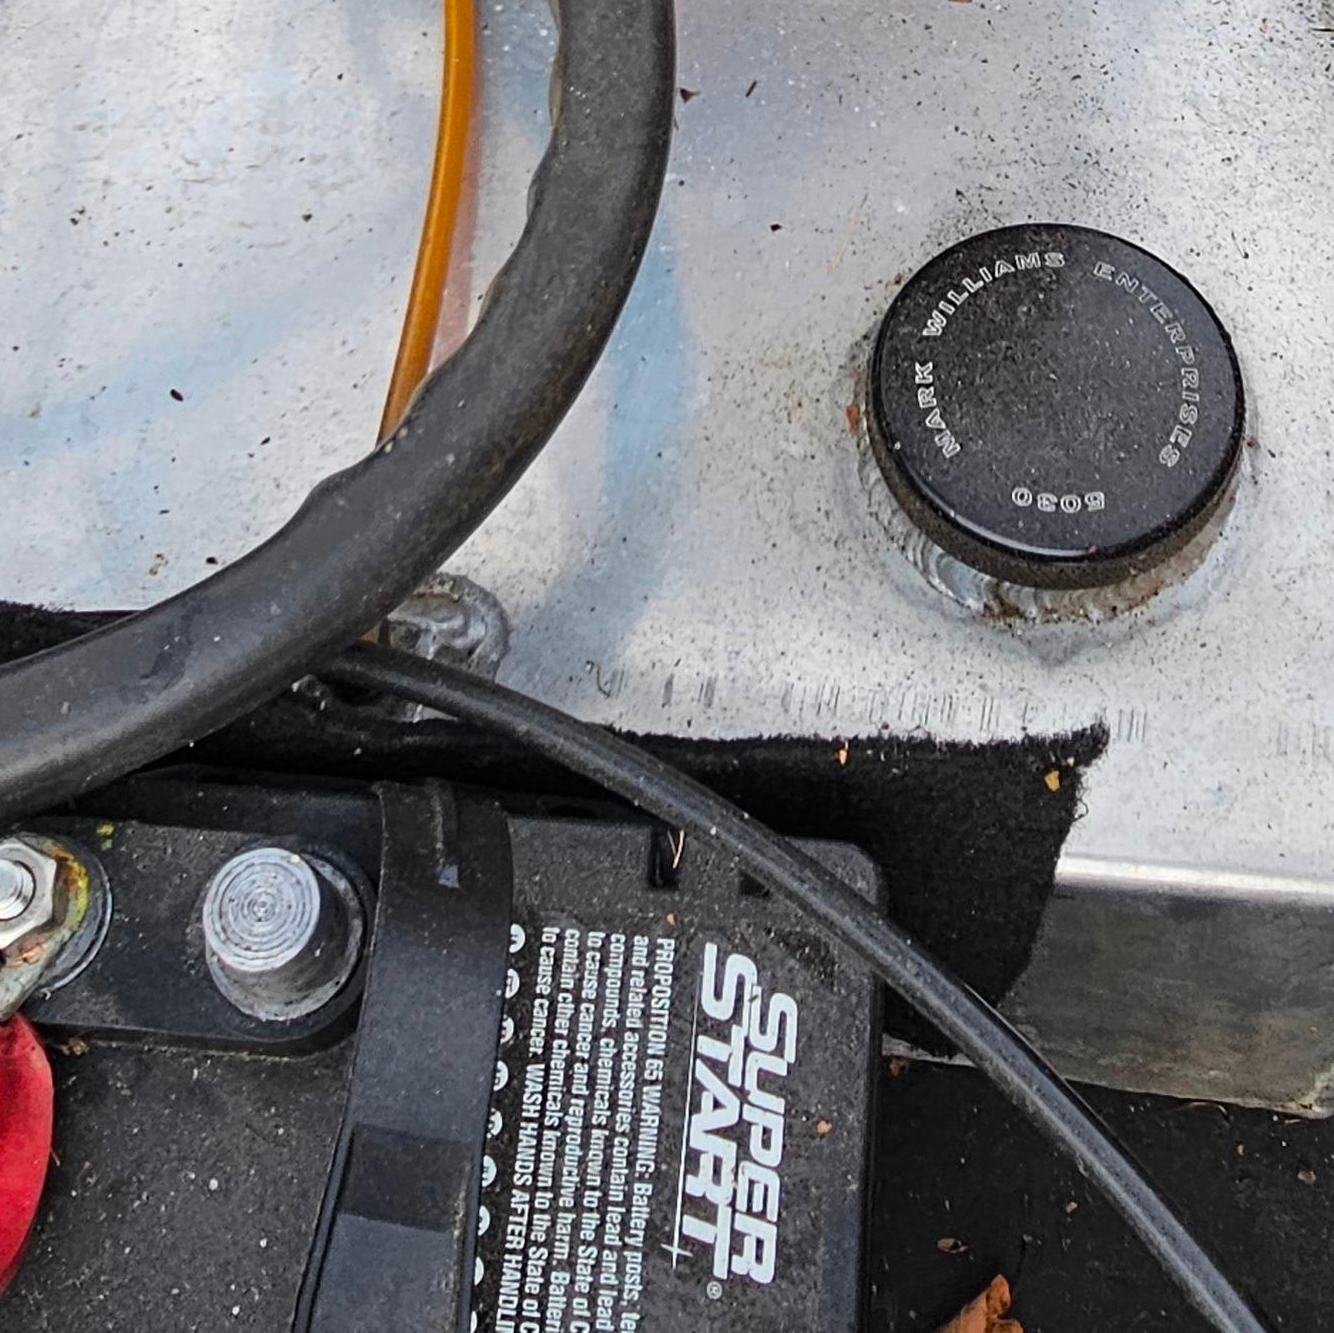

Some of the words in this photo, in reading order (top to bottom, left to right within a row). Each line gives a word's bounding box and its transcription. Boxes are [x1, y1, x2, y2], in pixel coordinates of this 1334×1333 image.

[923, 251, 1066, 337] WILLIAMS
[1093, 261, 1200, 467] ENTERPRISES
[915, 362, 962, 458] MARK
[542, 927, 560, 943] to
[560, 928, 580, 989] contain
[587, 932, 606, 948] to
[632, 935, 650, 967] and
[536, 946, 555, 995] cause
[582, 951, 600, 999] cause
[647, 938, 675, 1055] PROPOSITION
[626, 970, 647, 1028] related
[529, 999, 549, 1057] cancer.
[576, 1003, 595, 1059] cancer
[522, 1064, 545, 1117] WASH
[544, 1039, 570, 1126] chemicals
[572, 1063, 589, 1095] and
[592, 1038, 617, 1125] chemicals
[615, 1031, 639, 1133] accessories
[644, 1059, 663, 1080] 65
[635, 1084, 662, 1178] WARNING:
[682, 942, 757, 1280] START
[731, 985, 798, 1285] SUPER
[513, 1122, 538, 1185] HANDS
[537, 1130, 561, 1186] known
[559, 1098, 584, 1207] reproductive
[586, 1129, 609, 1186] known
[608, 1136, 629, 1201] contain
[506, 1189, 529, 1249] AFTER
[535, 1192, 553, 1209] to
[580, 1212, 600, 1240] the
[583, 1191, 602, 1208] to
[604, 1206, 626, 1246] lead
[624, 1182, 653, 1247] Battery
[530, 1214, 551, 1242] the
[525, 1247, 548, 1294] State
[574, 1246, 598, 1293] State
[600, 1249, 619, 1285] and
[620, 1251, 643, 1306] posts,
[522, 1299, 540, 1317] of
[572, 1297, 591, 1317] of
[596, 1289, 618, 1331] lead
